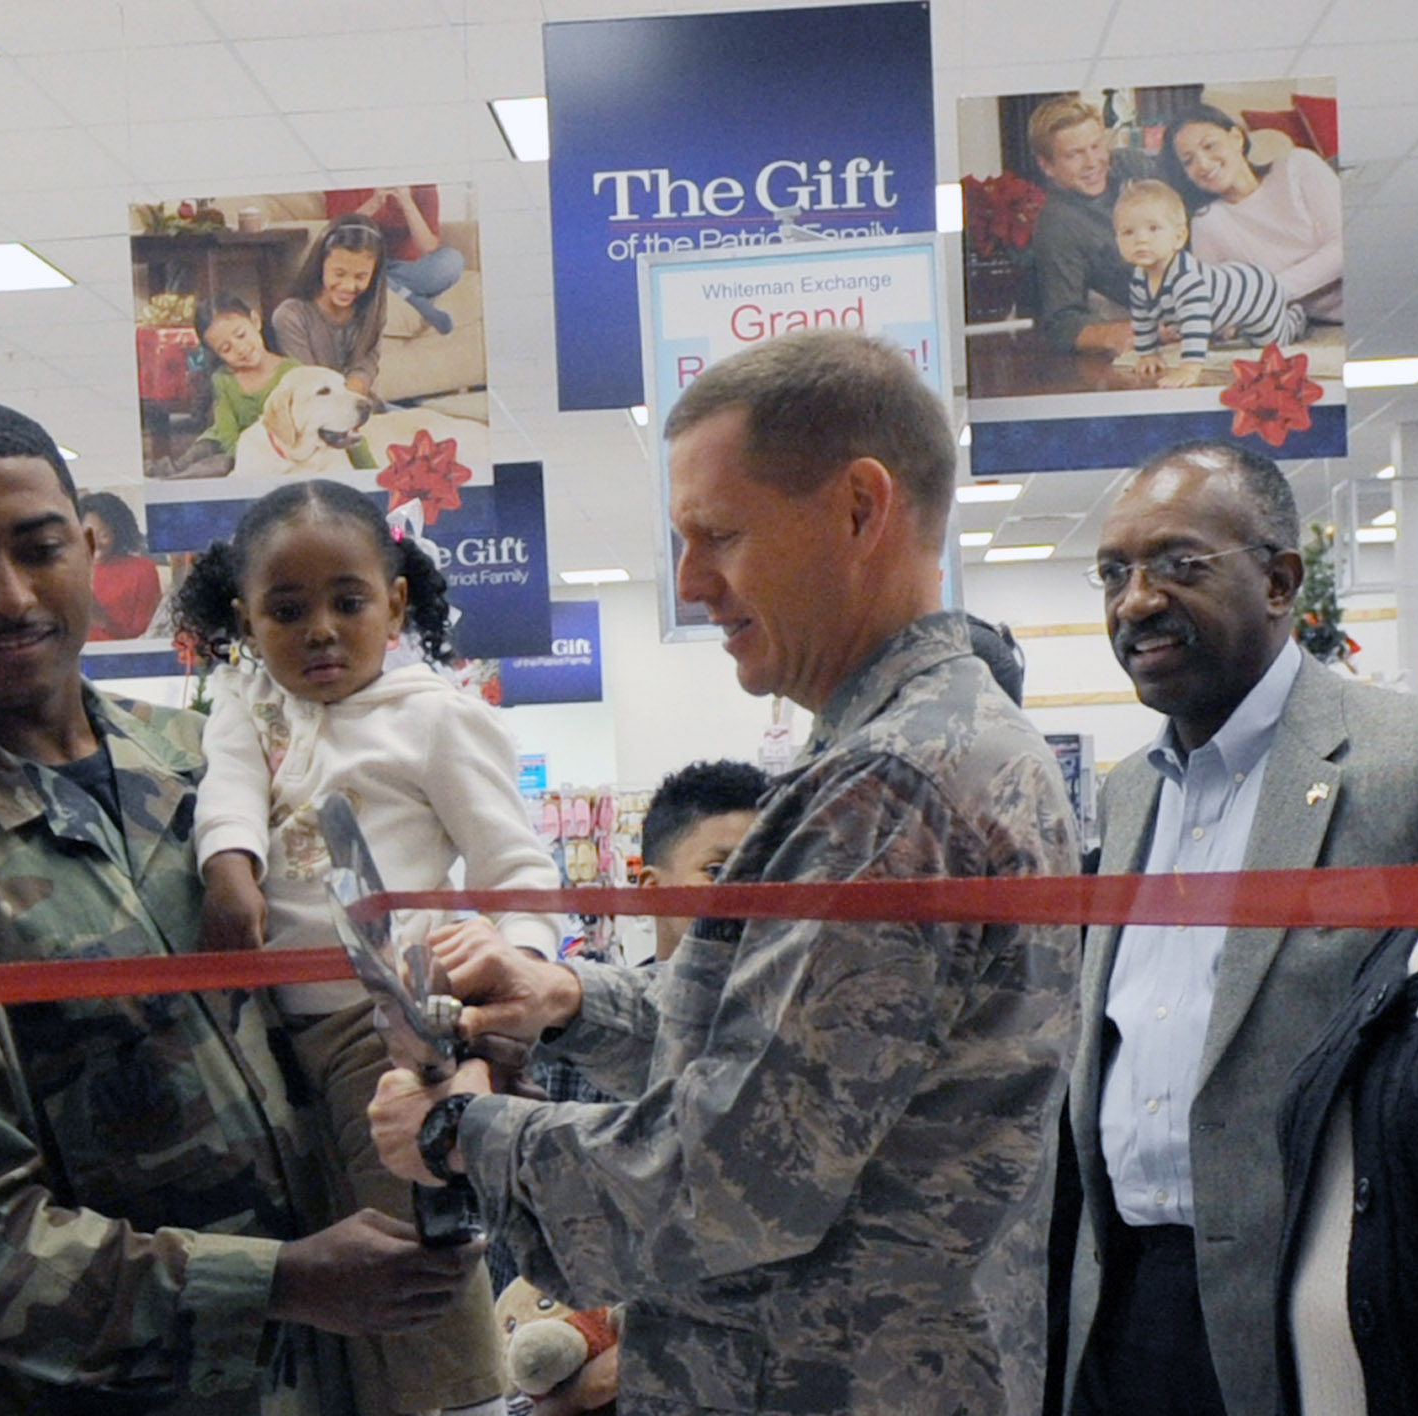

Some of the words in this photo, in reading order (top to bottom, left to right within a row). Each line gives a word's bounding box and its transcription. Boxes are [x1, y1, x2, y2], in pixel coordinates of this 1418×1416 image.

[592, 168, 745, 221] The
[755, 157, 898, 213] Gift
[607, 237, 638, 261] of
[643, 232, 695, 254] the
[699, 227, 781, 250] Patri
[702, 280, 794, 300] Whiteman
[800, 273, 892, 293] Exchange
[731, 296, 864, 342] Grand
[456, 536, 529, 566] Gift
[450, 570, 478, 586] triot
[481, 569, 529, 586] Family
[551, 638, 593, 656] Gift
